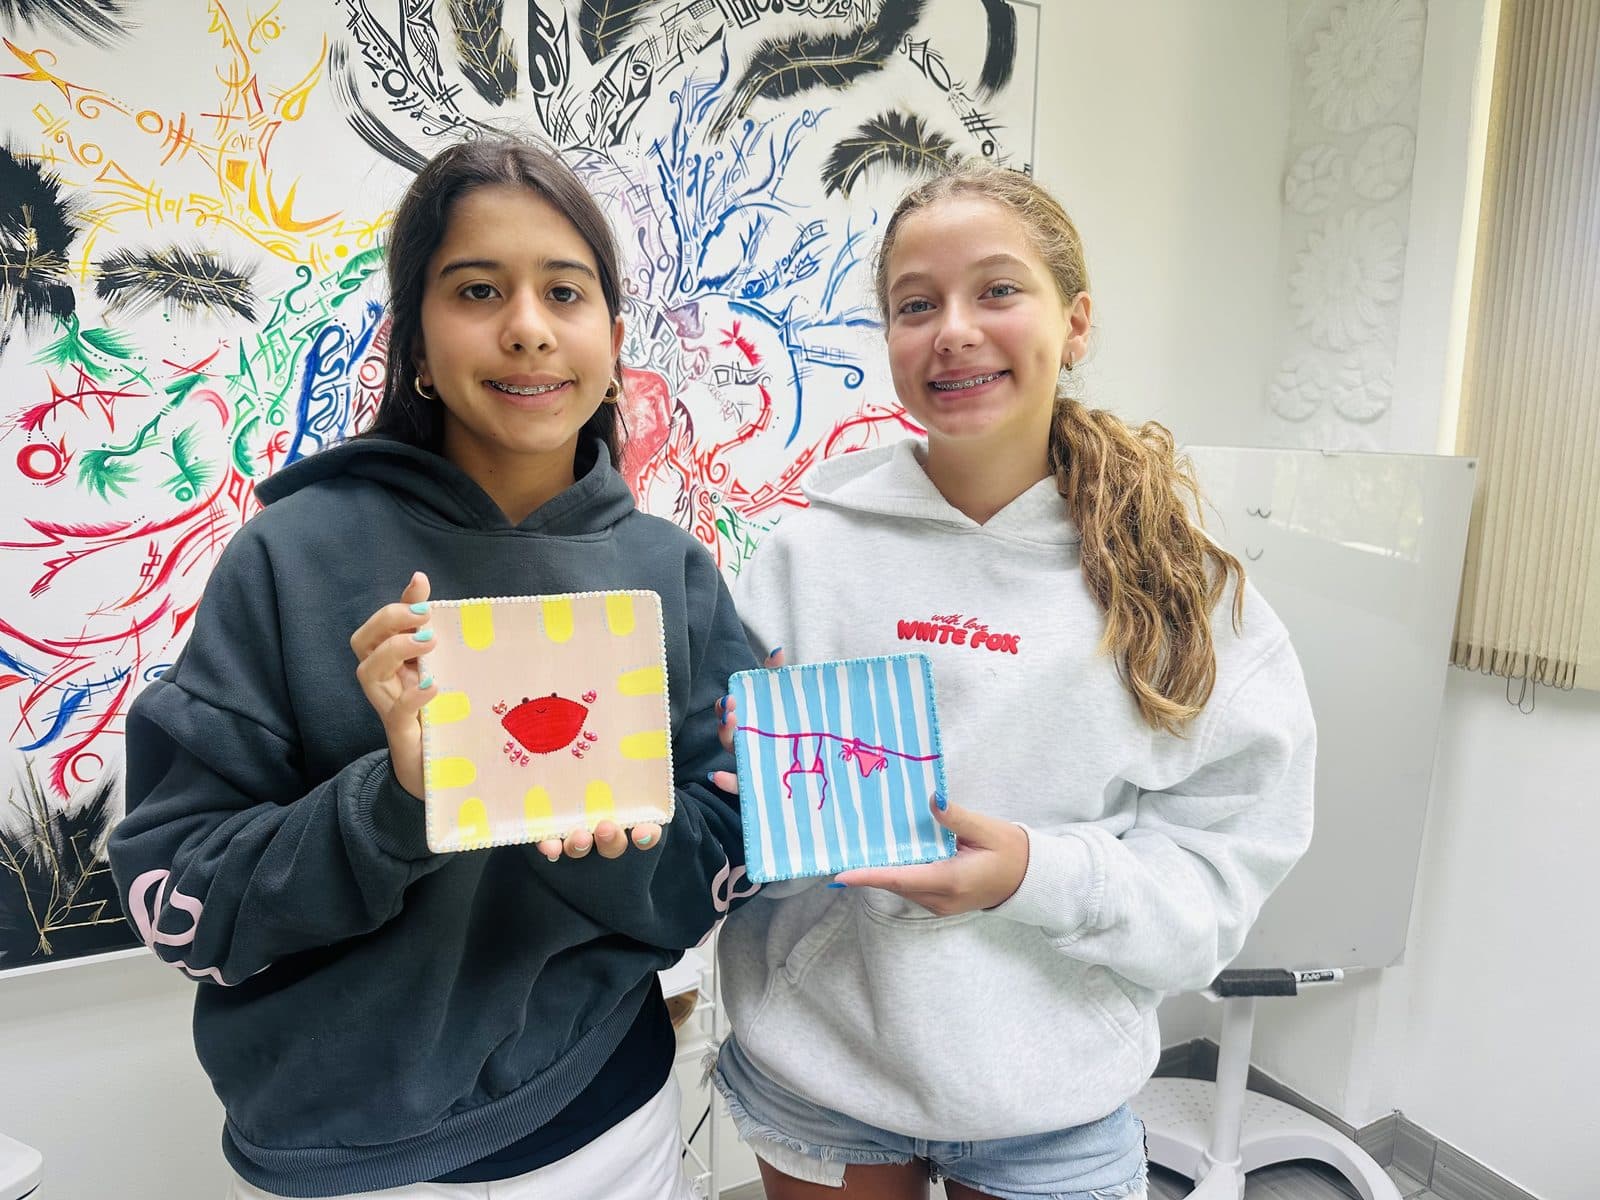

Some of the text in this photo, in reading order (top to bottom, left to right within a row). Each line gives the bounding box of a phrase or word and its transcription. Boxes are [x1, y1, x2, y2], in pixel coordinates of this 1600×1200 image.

[931, 614, 989, 632] with love
[897, 619, 1021, 655] WHITE FOX
